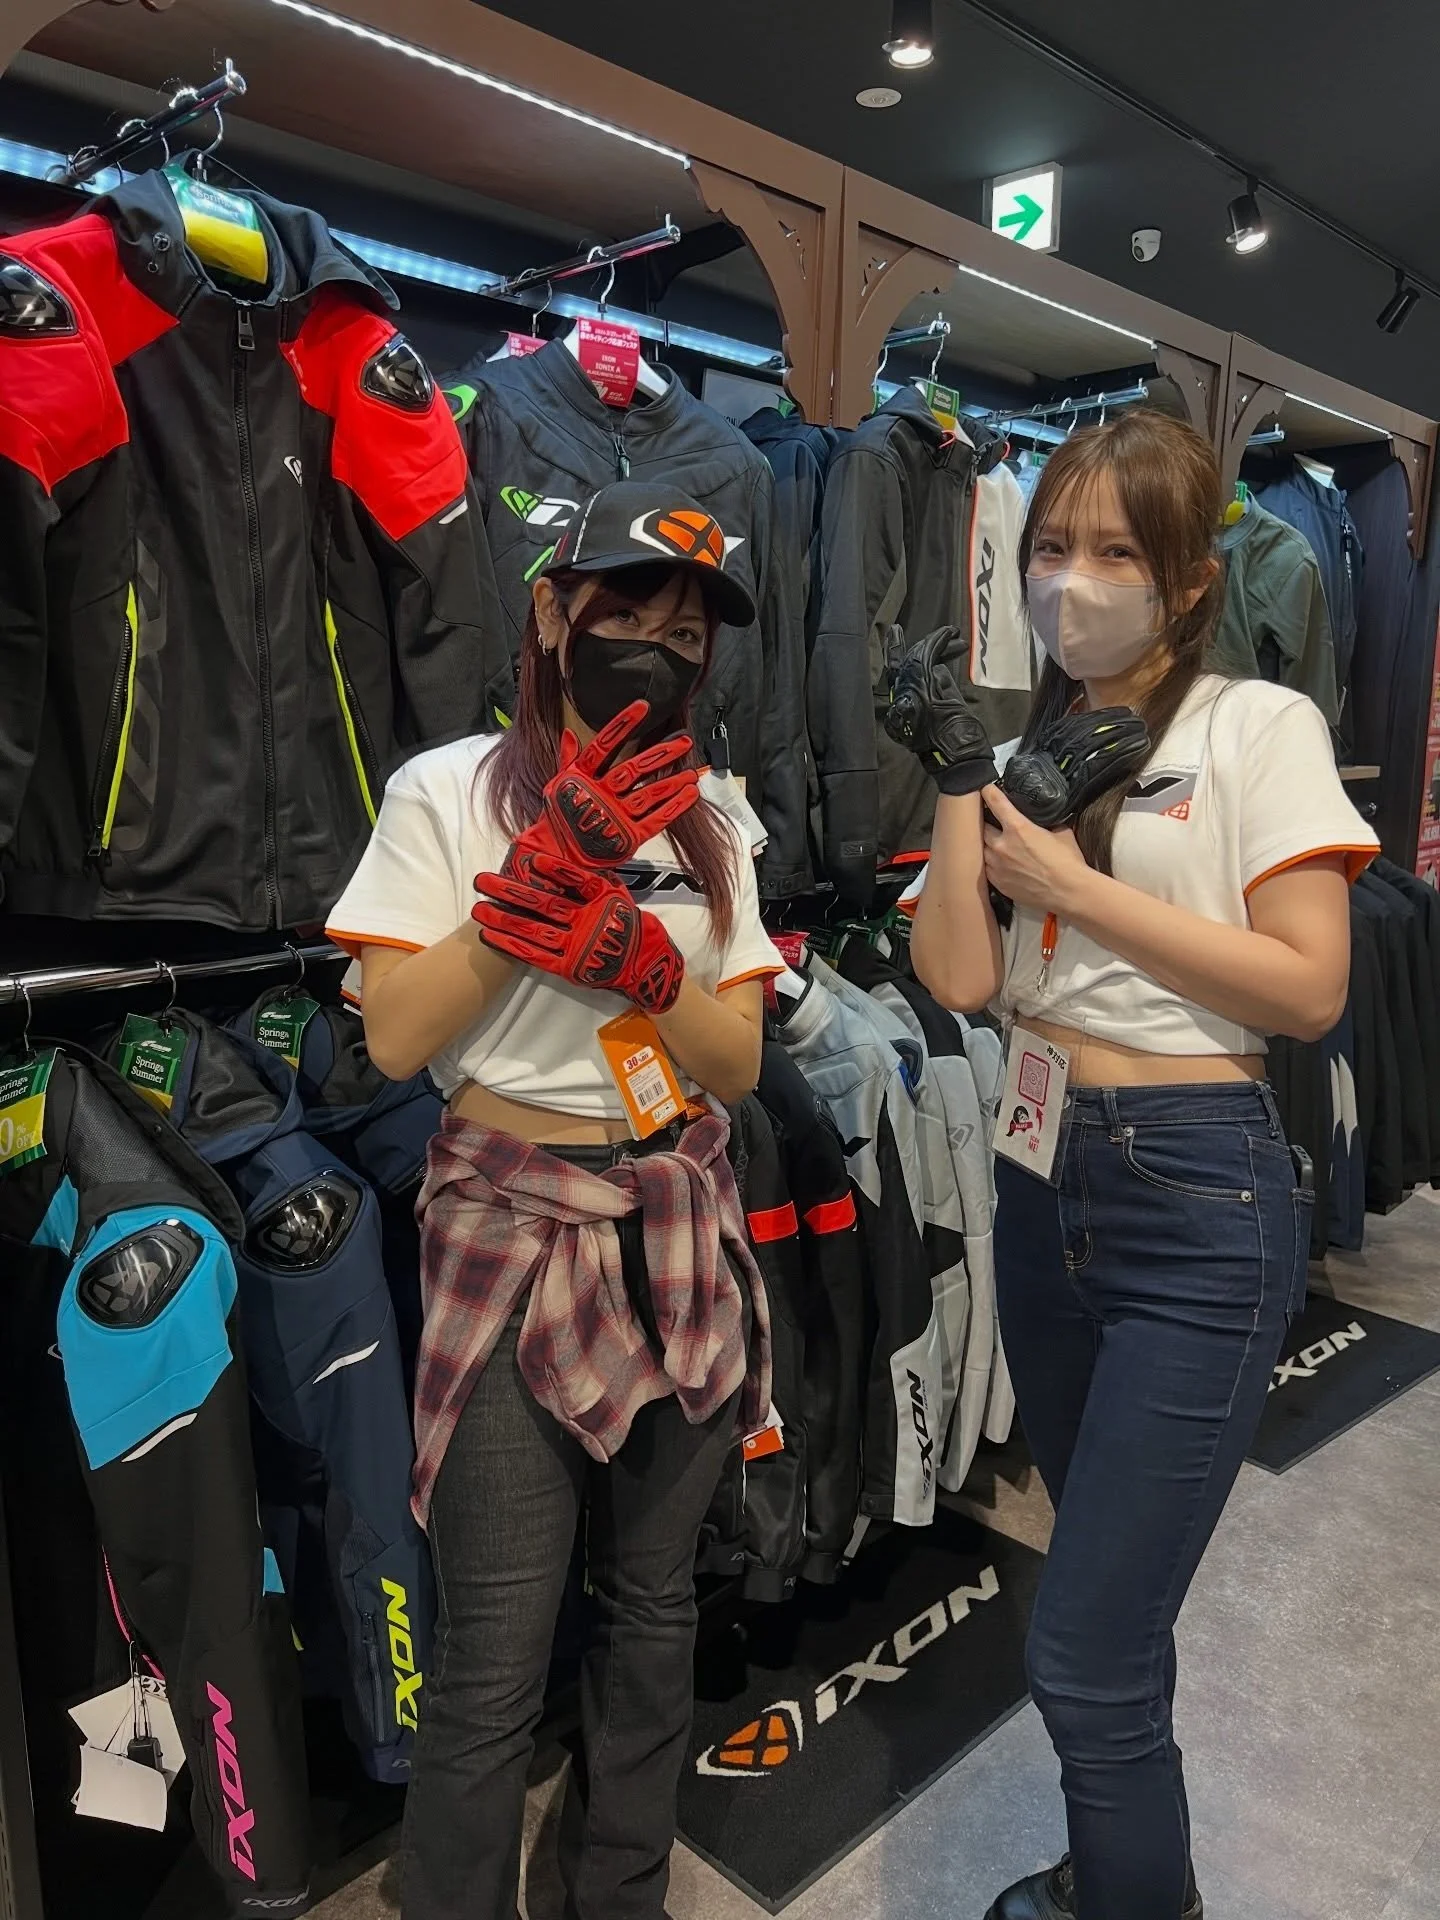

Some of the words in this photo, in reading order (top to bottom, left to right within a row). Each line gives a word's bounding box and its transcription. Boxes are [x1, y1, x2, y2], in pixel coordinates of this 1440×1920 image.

[626, 1056, 638, 1069] 30
[0, 1076, 28, 1092] pring&
[130, 1065, 164, 1084] Summer
[0, 1085, 29, 1103] ummer
[815, 1565, 1000, 1725] IXON
[381, 1577, 423, 1733] IXON
[207, 1681, 255, 1882] IXON
